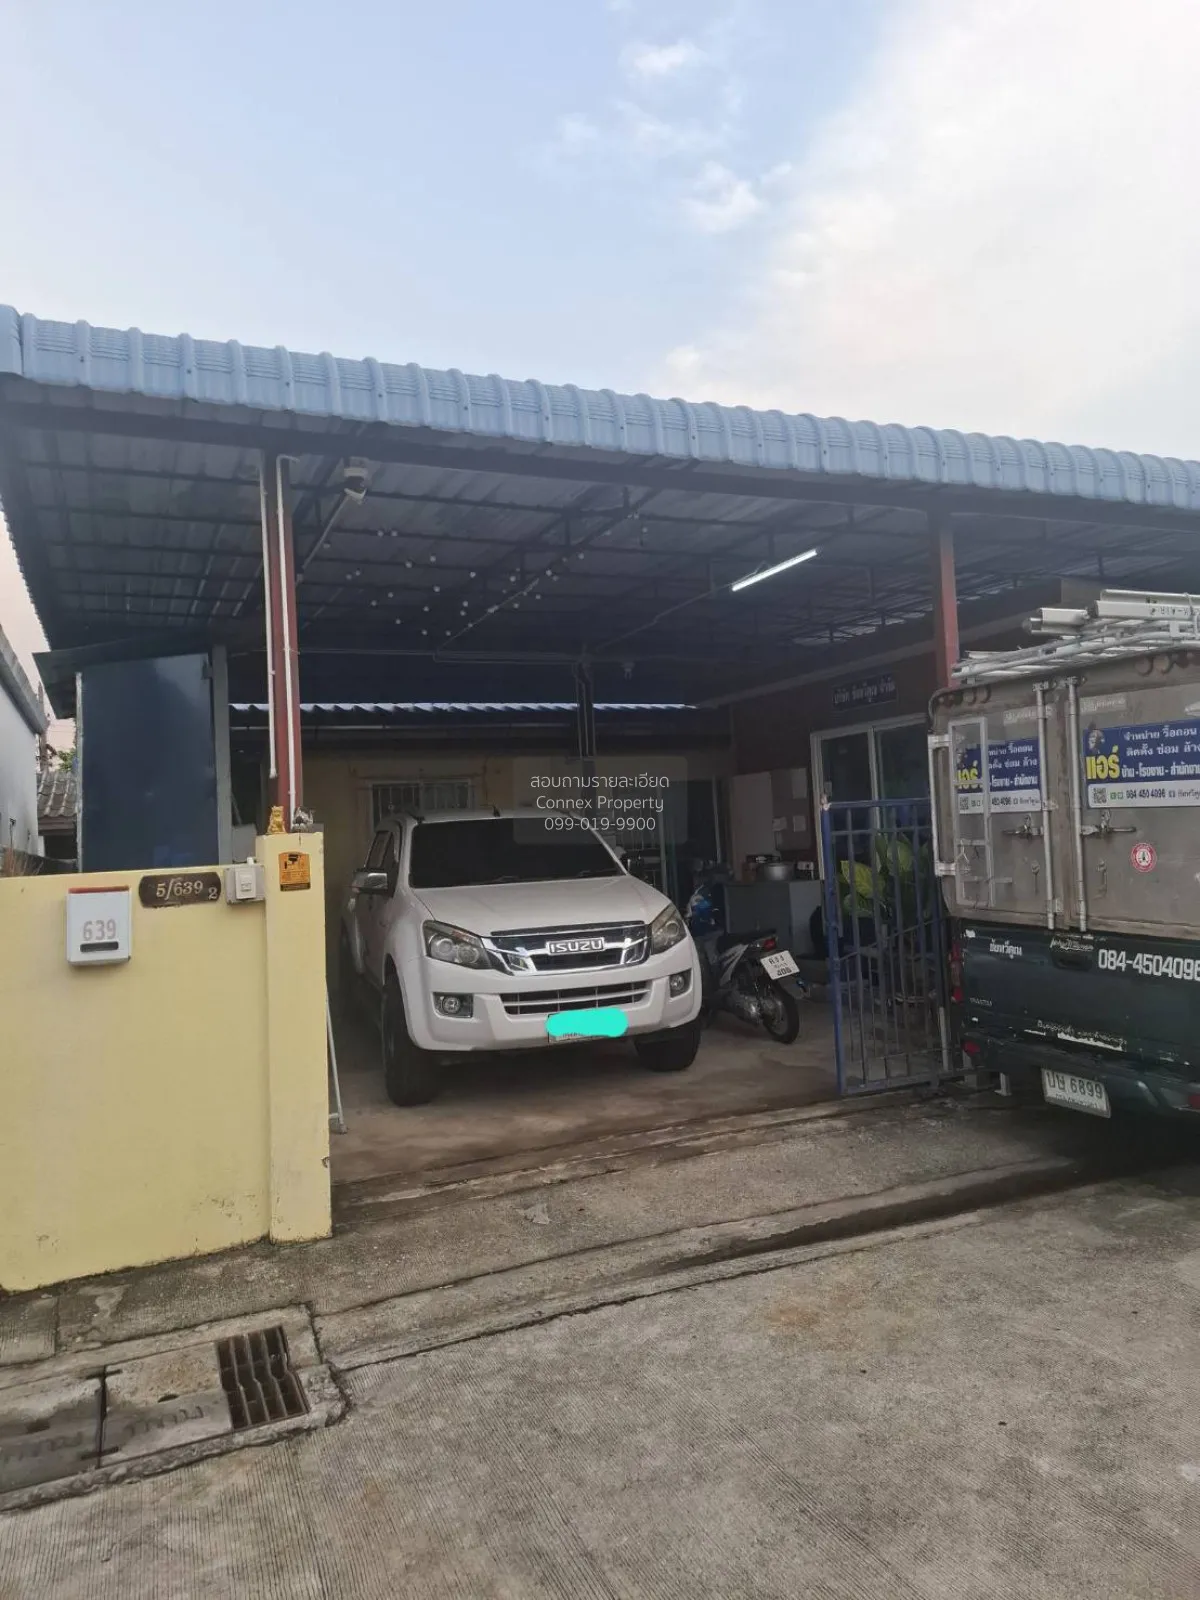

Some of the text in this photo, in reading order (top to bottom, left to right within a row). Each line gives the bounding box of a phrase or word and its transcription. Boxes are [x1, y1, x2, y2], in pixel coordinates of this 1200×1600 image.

[1086, 745, 1120, 779] แอร์
[156, 878, 203, 901] 5/639
[83, 918, 117, 941] 639
[550, 939, 602, 953] ISUZU
[1070, 1078, 1103, 1099] 6899
